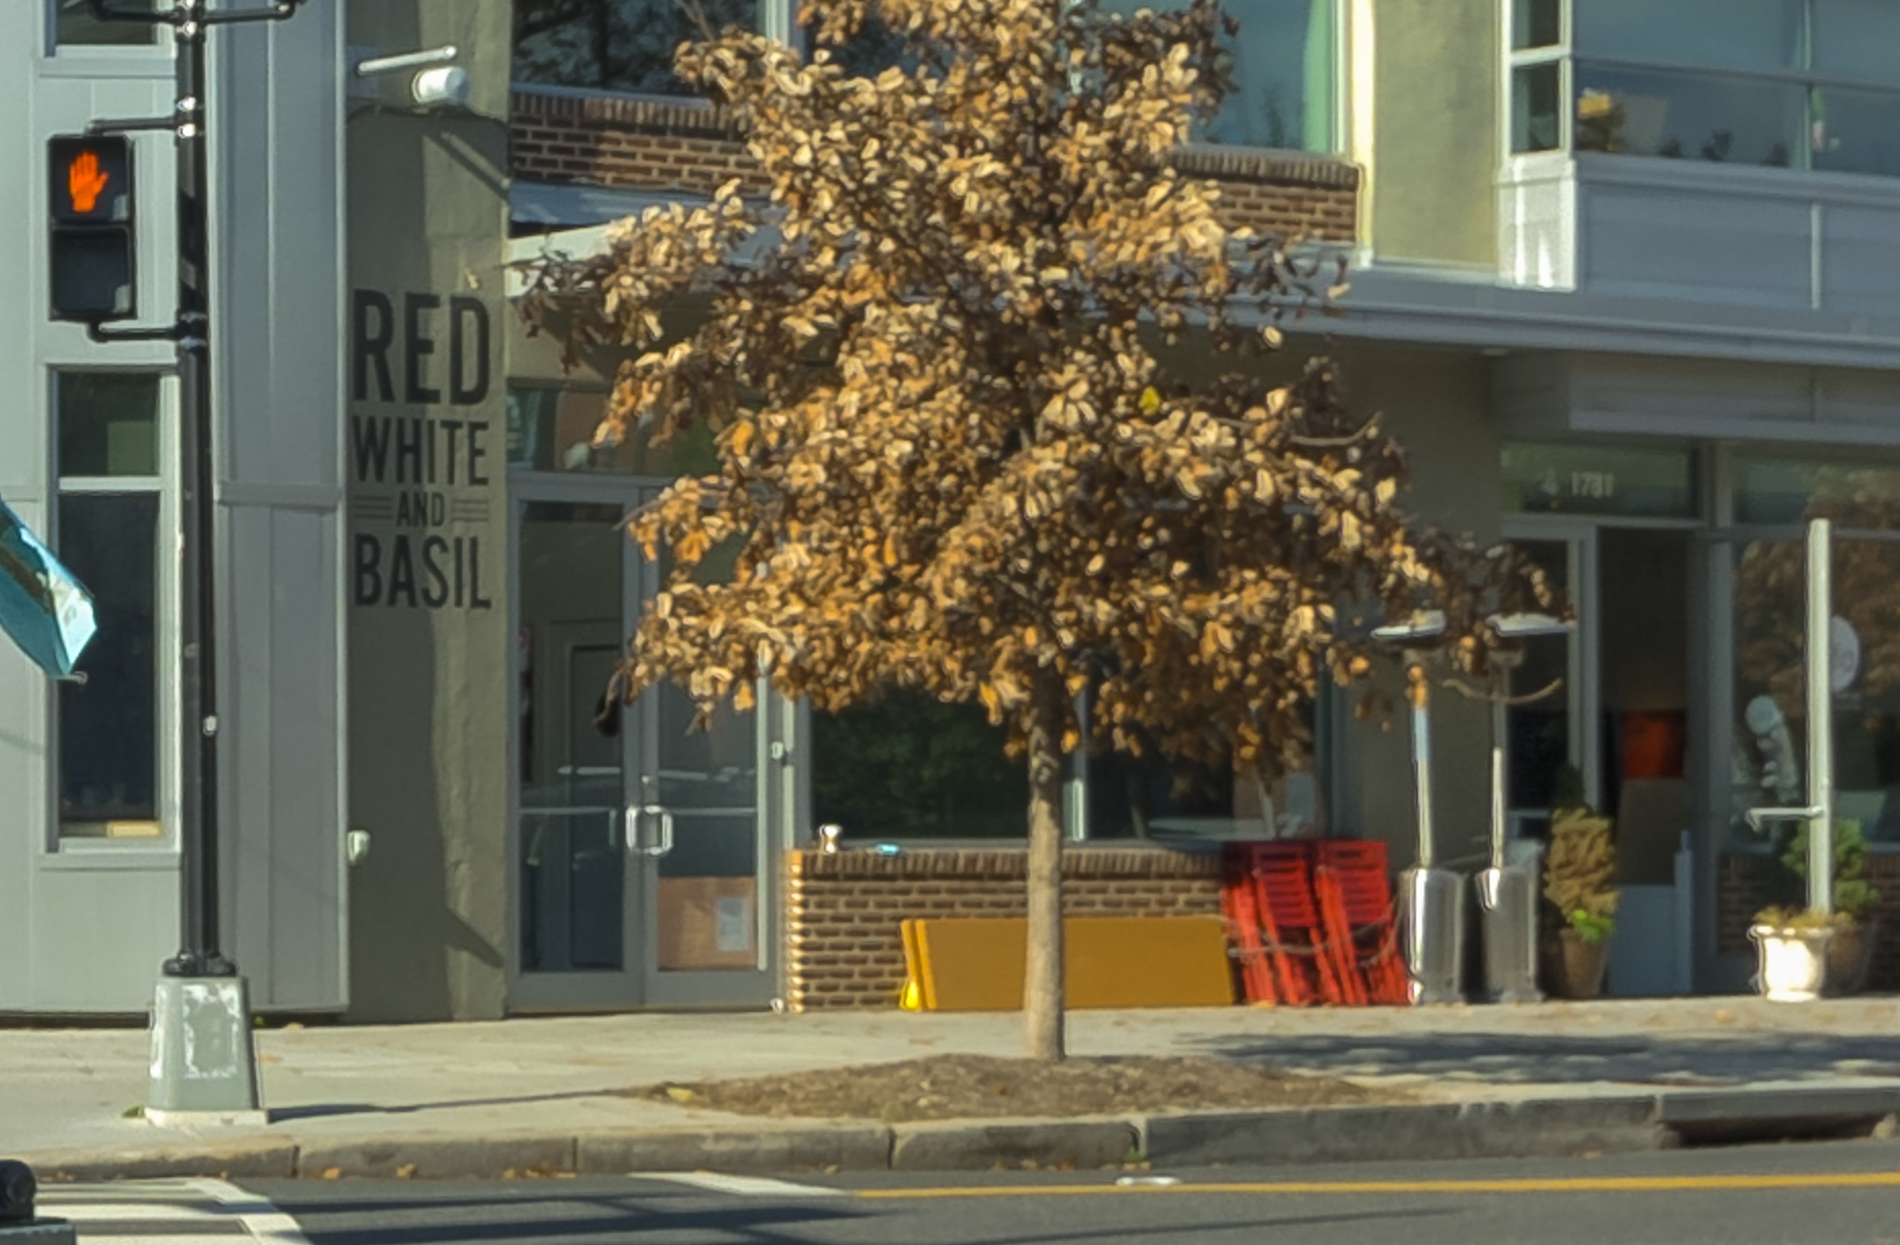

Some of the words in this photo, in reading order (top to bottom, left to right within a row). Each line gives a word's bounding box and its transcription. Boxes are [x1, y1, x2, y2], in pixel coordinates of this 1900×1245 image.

[353, 289, 491, 406] RED
[352, 414, 490, 487] WHITE
[395, 489, 446, 528] AND
[354, 533, 492, 610] BASIL
